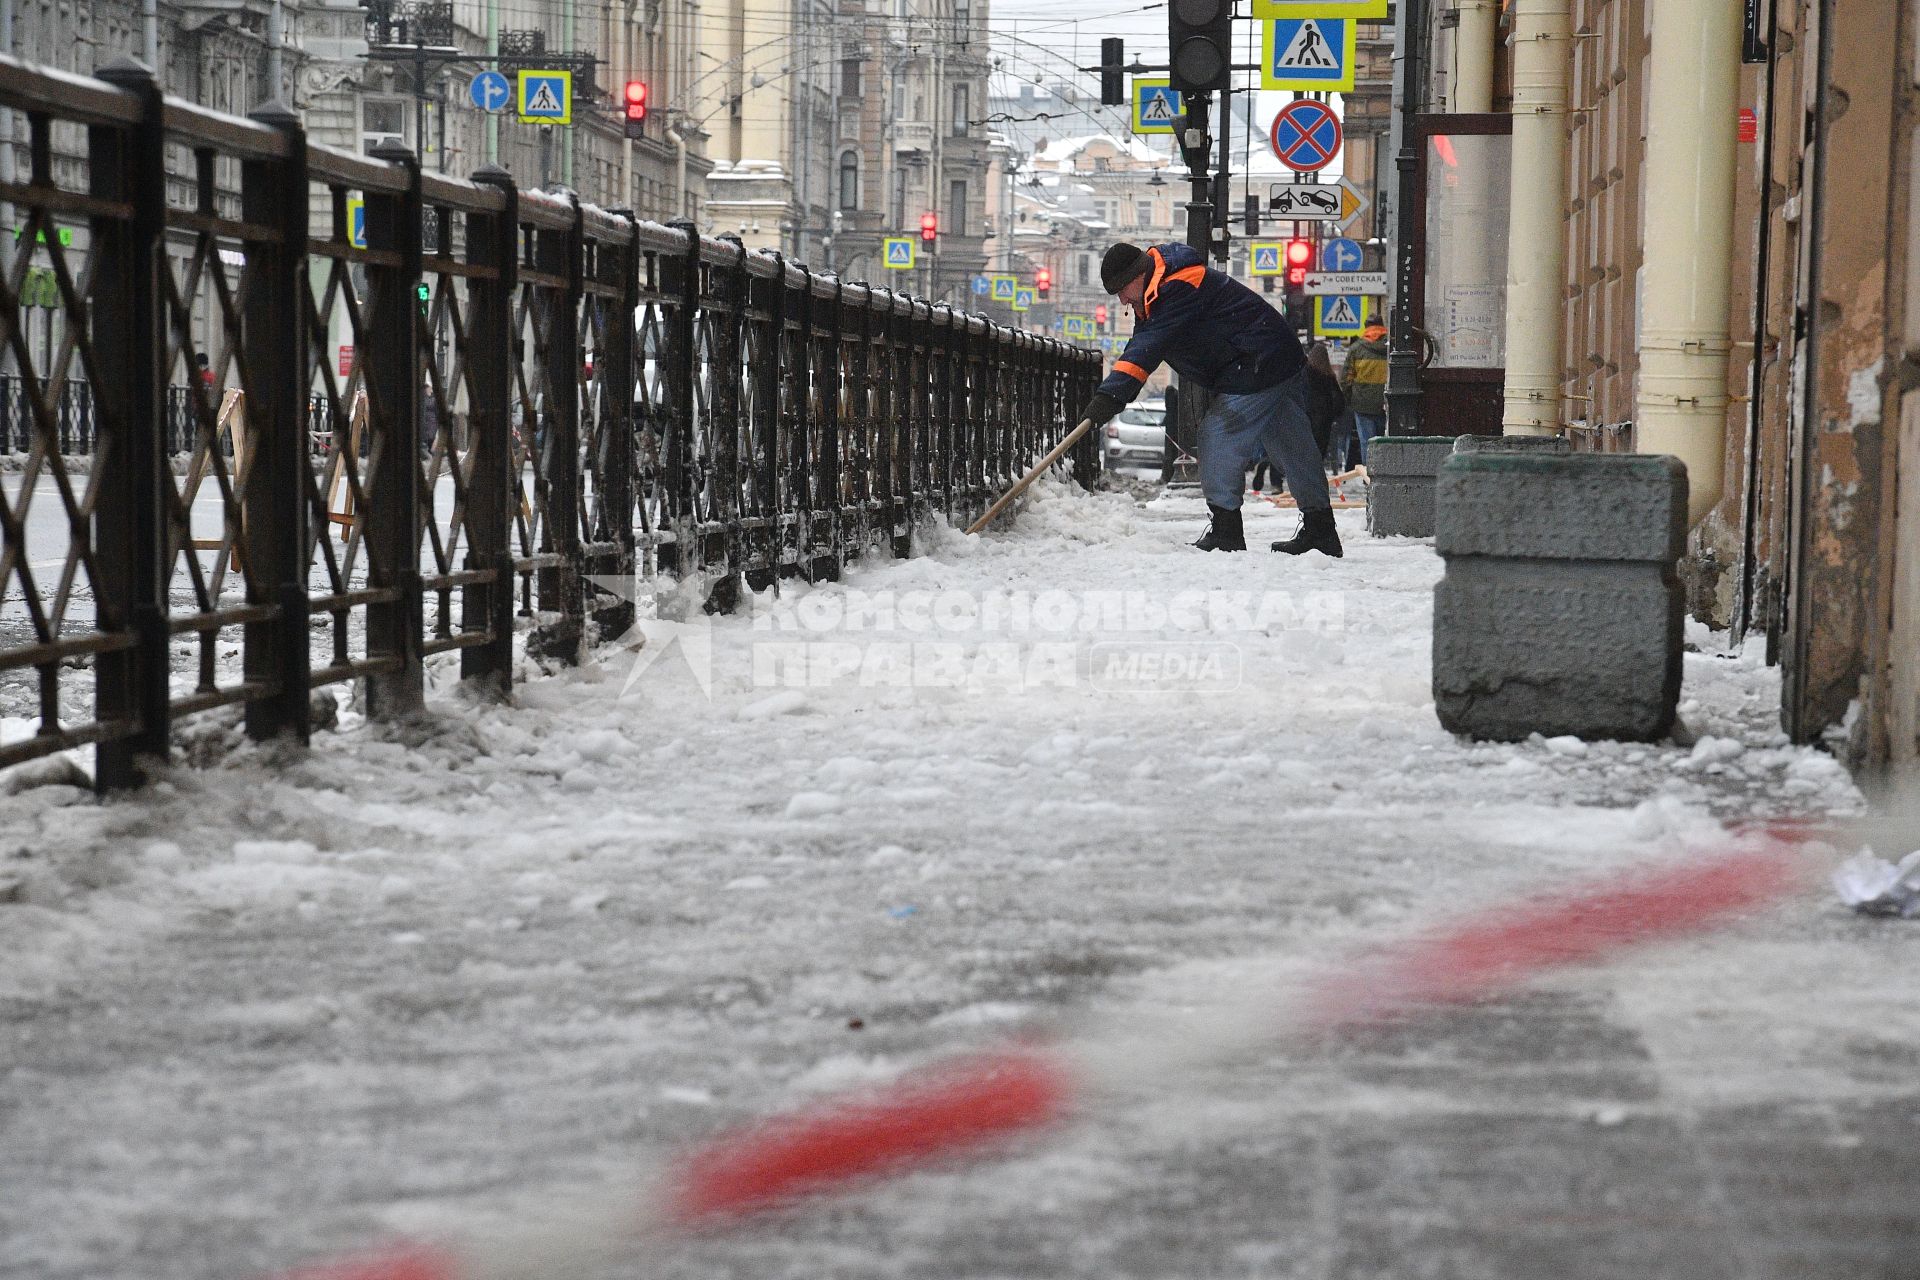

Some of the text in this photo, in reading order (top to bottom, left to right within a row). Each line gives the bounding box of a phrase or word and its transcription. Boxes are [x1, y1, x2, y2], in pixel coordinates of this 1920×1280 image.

[1748, 11, 1753, 19] 3
[1747, 22, 1753, 30] 4
[1335, 275, 1382, 283] СОВЕТСКАЯ
